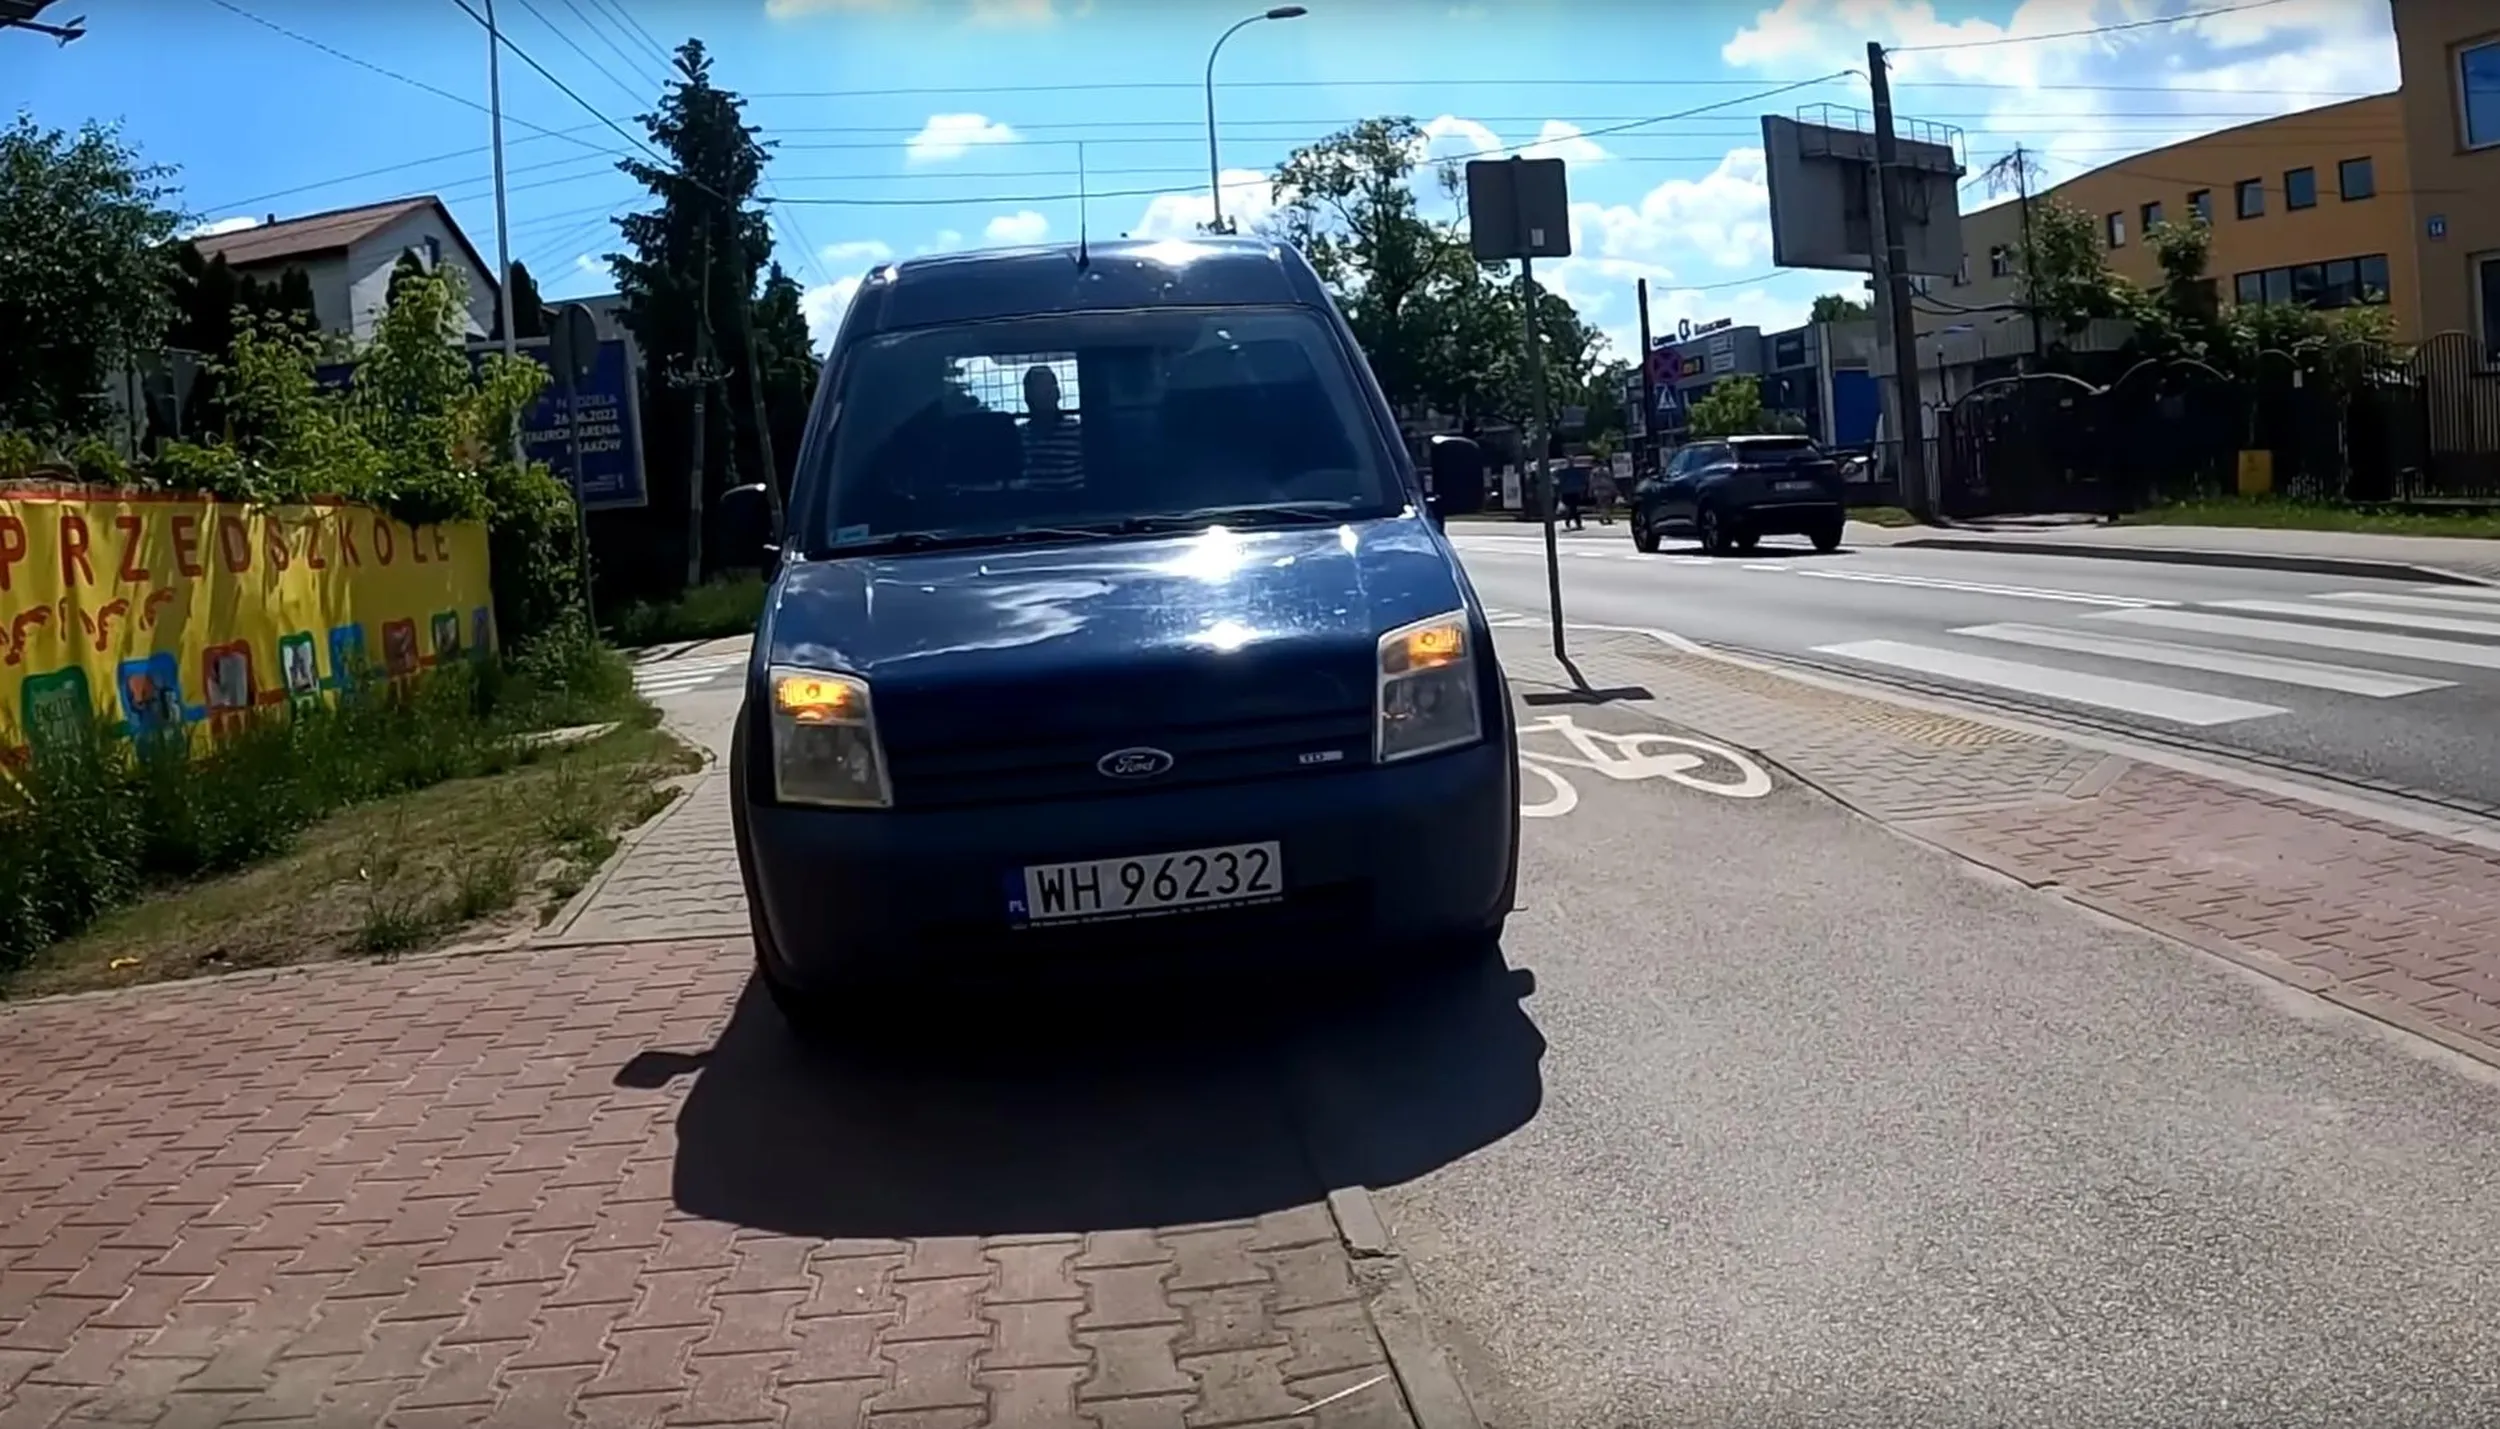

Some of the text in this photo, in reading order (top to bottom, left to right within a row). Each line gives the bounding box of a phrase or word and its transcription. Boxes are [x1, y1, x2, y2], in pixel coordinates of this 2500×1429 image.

[0, 514, 450, 590] PRZEDSZKOLE
[1036, 864, 1101, 914] WH
[1119, 848, 1273, 906] 96232
